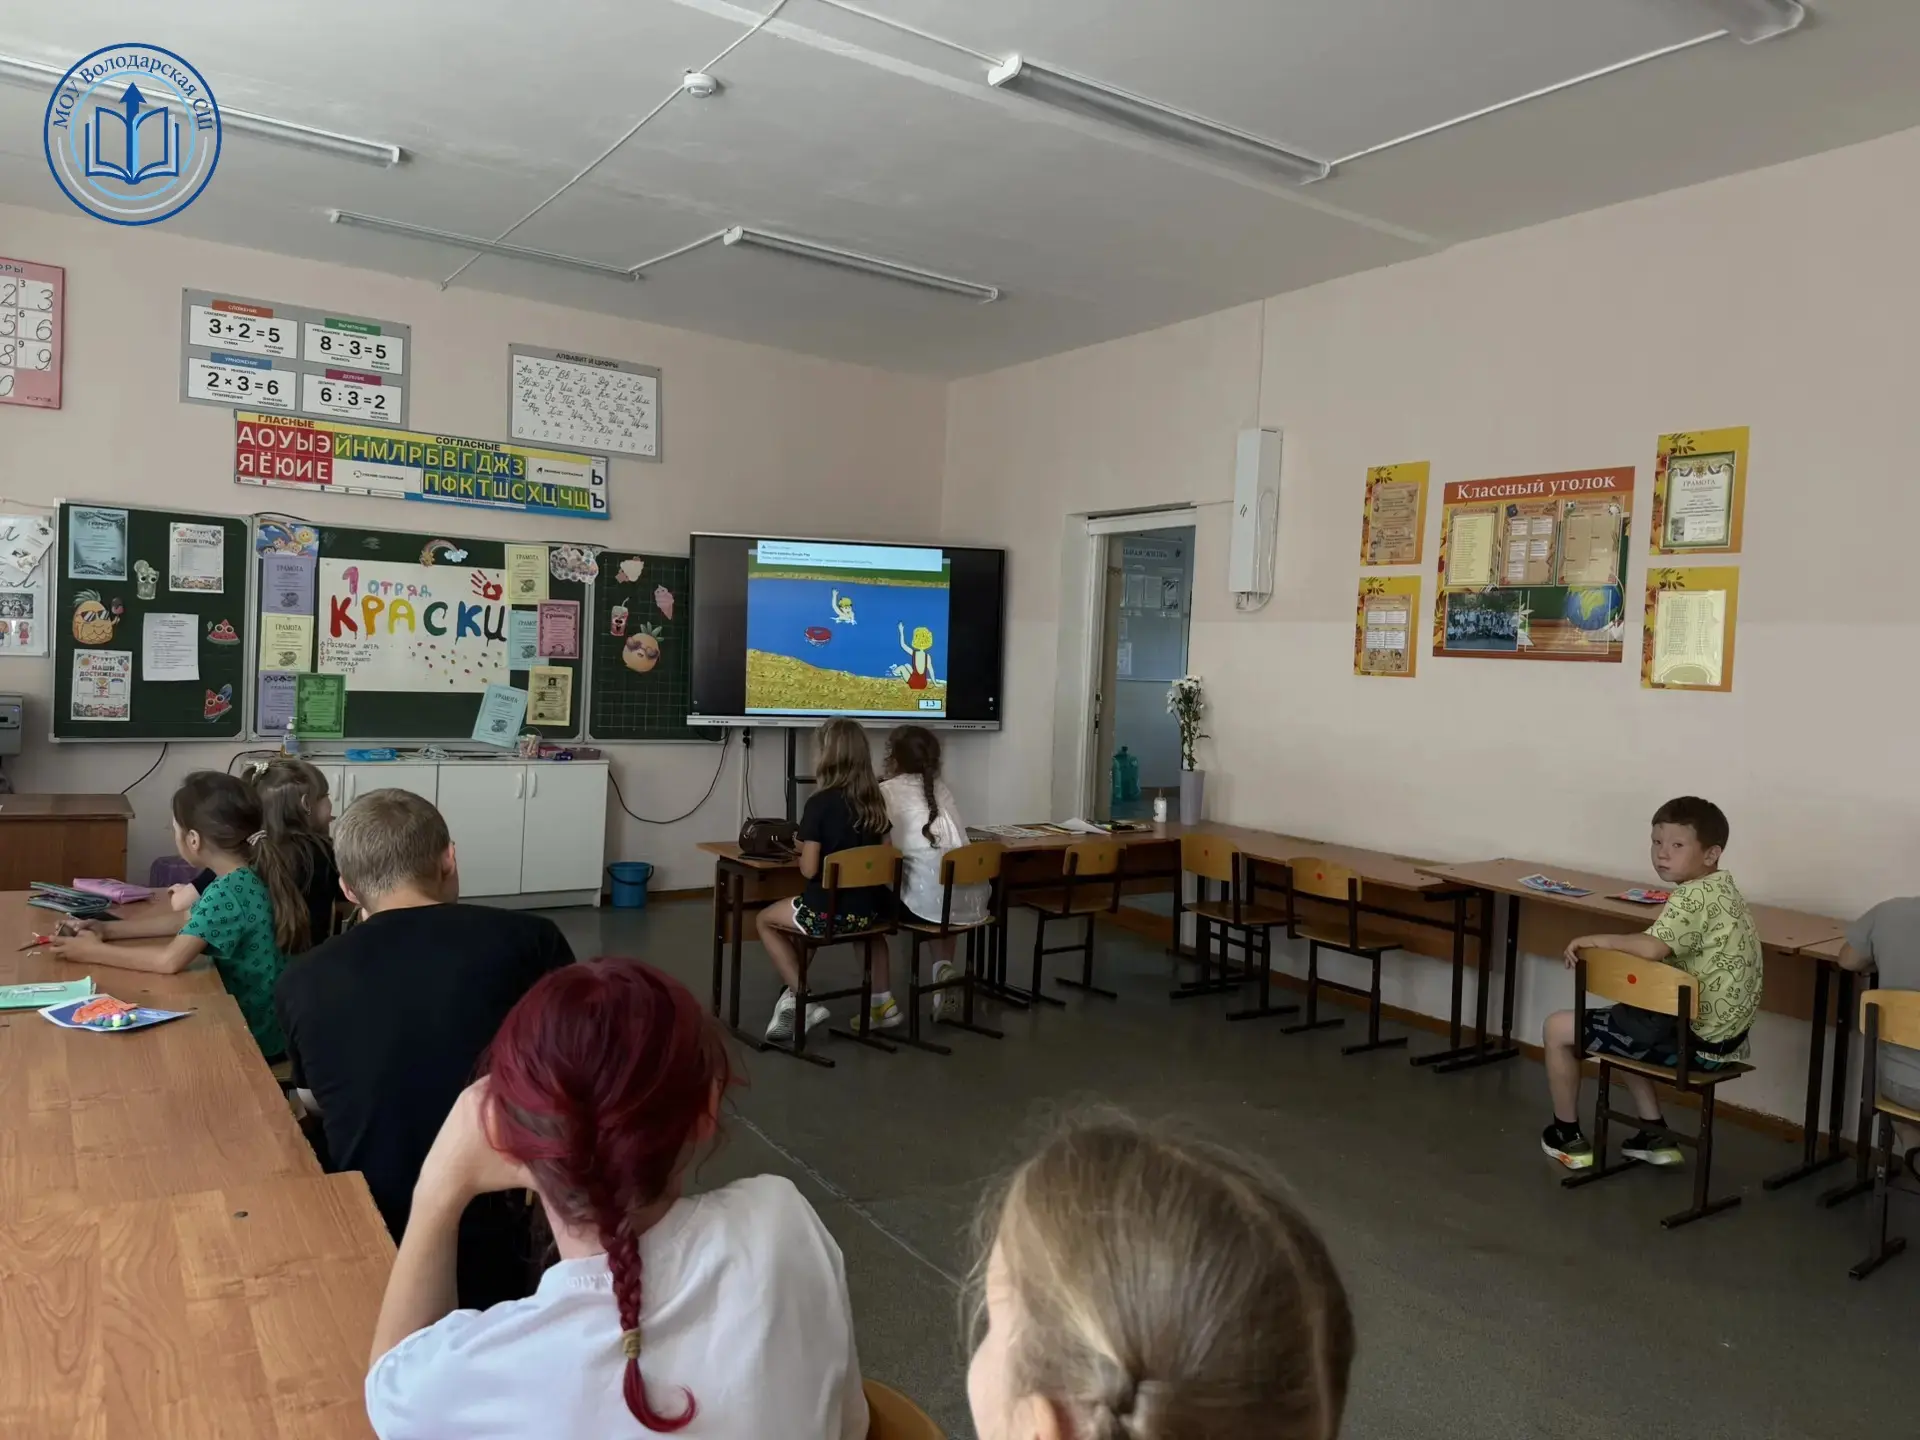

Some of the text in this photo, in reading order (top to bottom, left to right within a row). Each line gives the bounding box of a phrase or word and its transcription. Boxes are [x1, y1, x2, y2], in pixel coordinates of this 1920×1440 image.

[556, 353, 587, 364] АЛФАВИТ
[258, 414, 315, 428] ГЛАСНЫЕ
[436, 436, 500, 452] СОГЛАСНЫЕ
[591, 468, 603, 485] Ь
[1457, 475, 1616, 500] Классный уголок
[590, 492, 605, 509] Ъ
[276, 564, 303, 573] ГРАМОТА
[342, 566, 359, 597] 1
[330, 594, 507, 643] КРАСКИ
[275, 624, 302, 632] ГРАМОТА
[495, 692, 518, 704] ГРАМОТА
